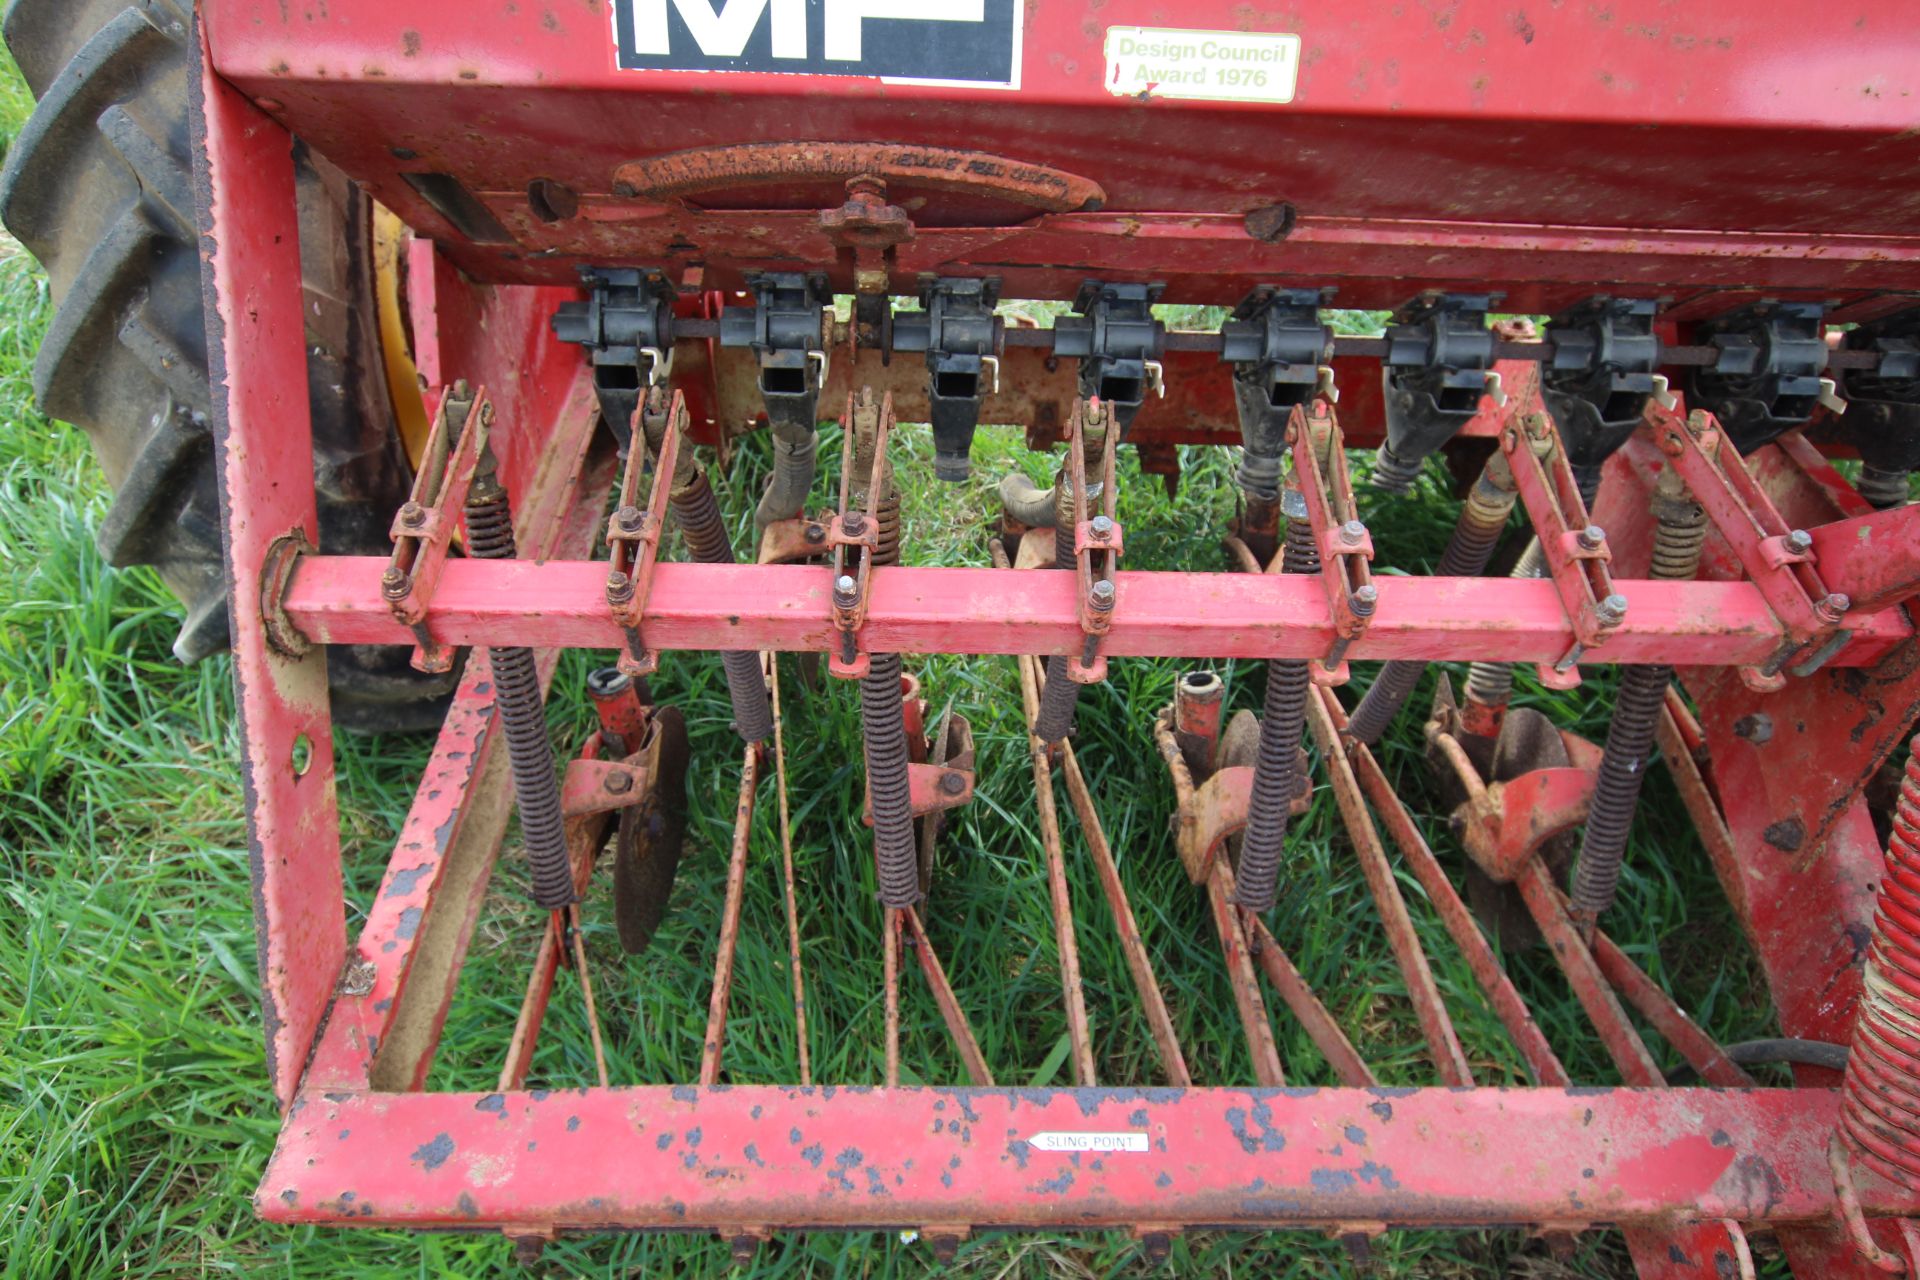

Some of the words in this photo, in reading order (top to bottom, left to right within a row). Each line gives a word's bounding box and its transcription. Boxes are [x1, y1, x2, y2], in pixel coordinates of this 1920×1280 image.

[1119, 37, 1196, 62] Design
[1200, 40, 1287, 63] Council
[1134, 63, 1207, 85] Award
[1216, 67, 1268, 88] 1976
[1046, 1135, 1088, 1148] SLING
[1093, 1135, 1135, 1148] POINT
